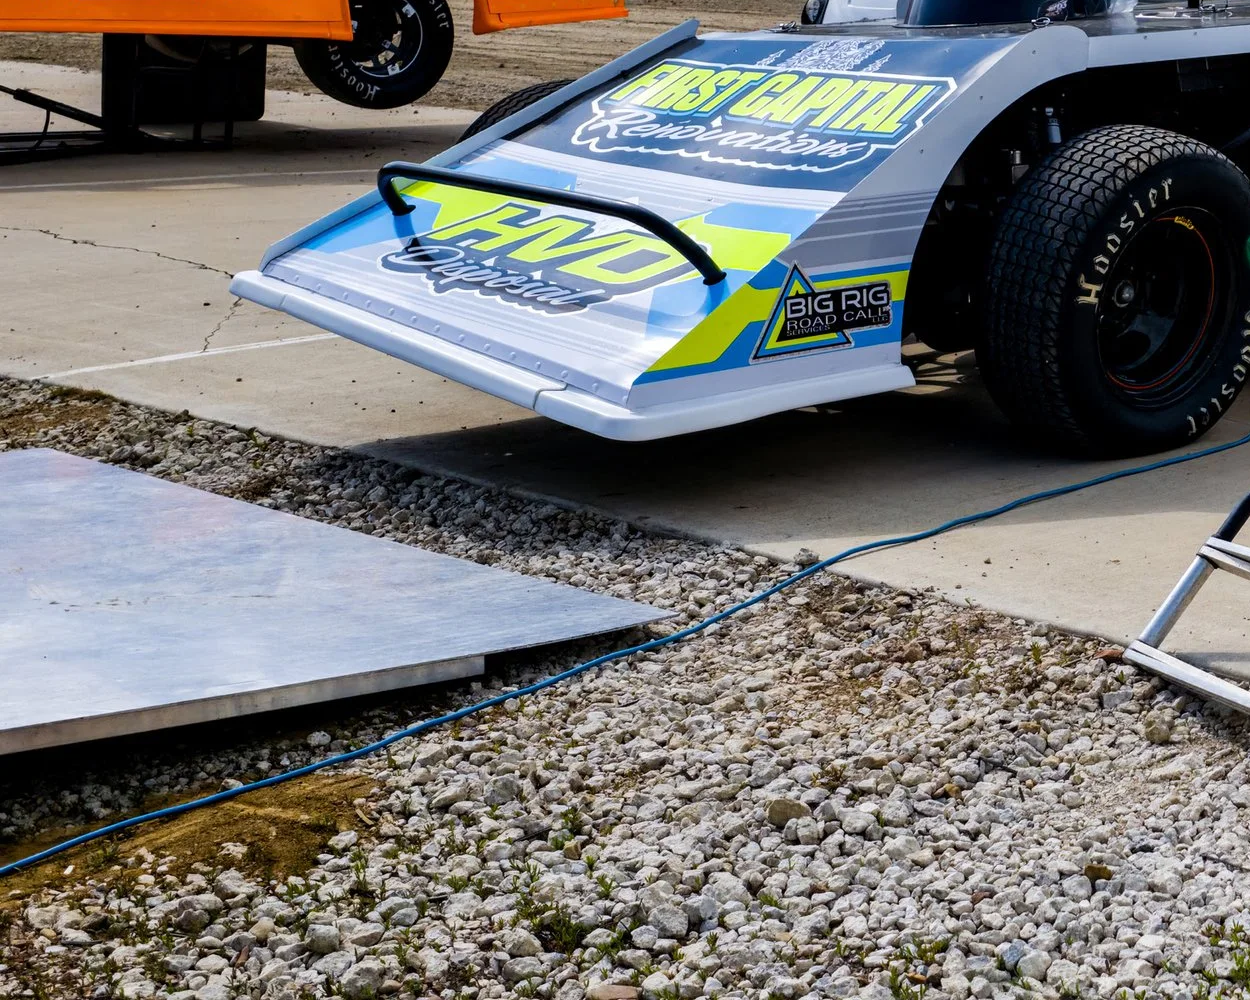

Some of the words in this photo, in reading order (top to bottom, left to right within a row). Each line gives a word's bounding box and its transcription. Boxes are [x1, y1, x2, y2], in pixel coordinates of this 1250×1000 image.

[611, 64, 758, 113] FIRST
[728, 74, 937, 133] CAPITAL
[592, 110, 868, 158] Renovations
[1075, 177, 1173, 313] Hoosier
[387, 245, 606, 305] Disposal
[786, 294, 834, 319] BIG
[841, 286, 888, 311] RIG
[786, 314, 837, 332] ROAD
[843, 307, 887, 322] CALL
[786, 324, 830, 337] SERVICES
